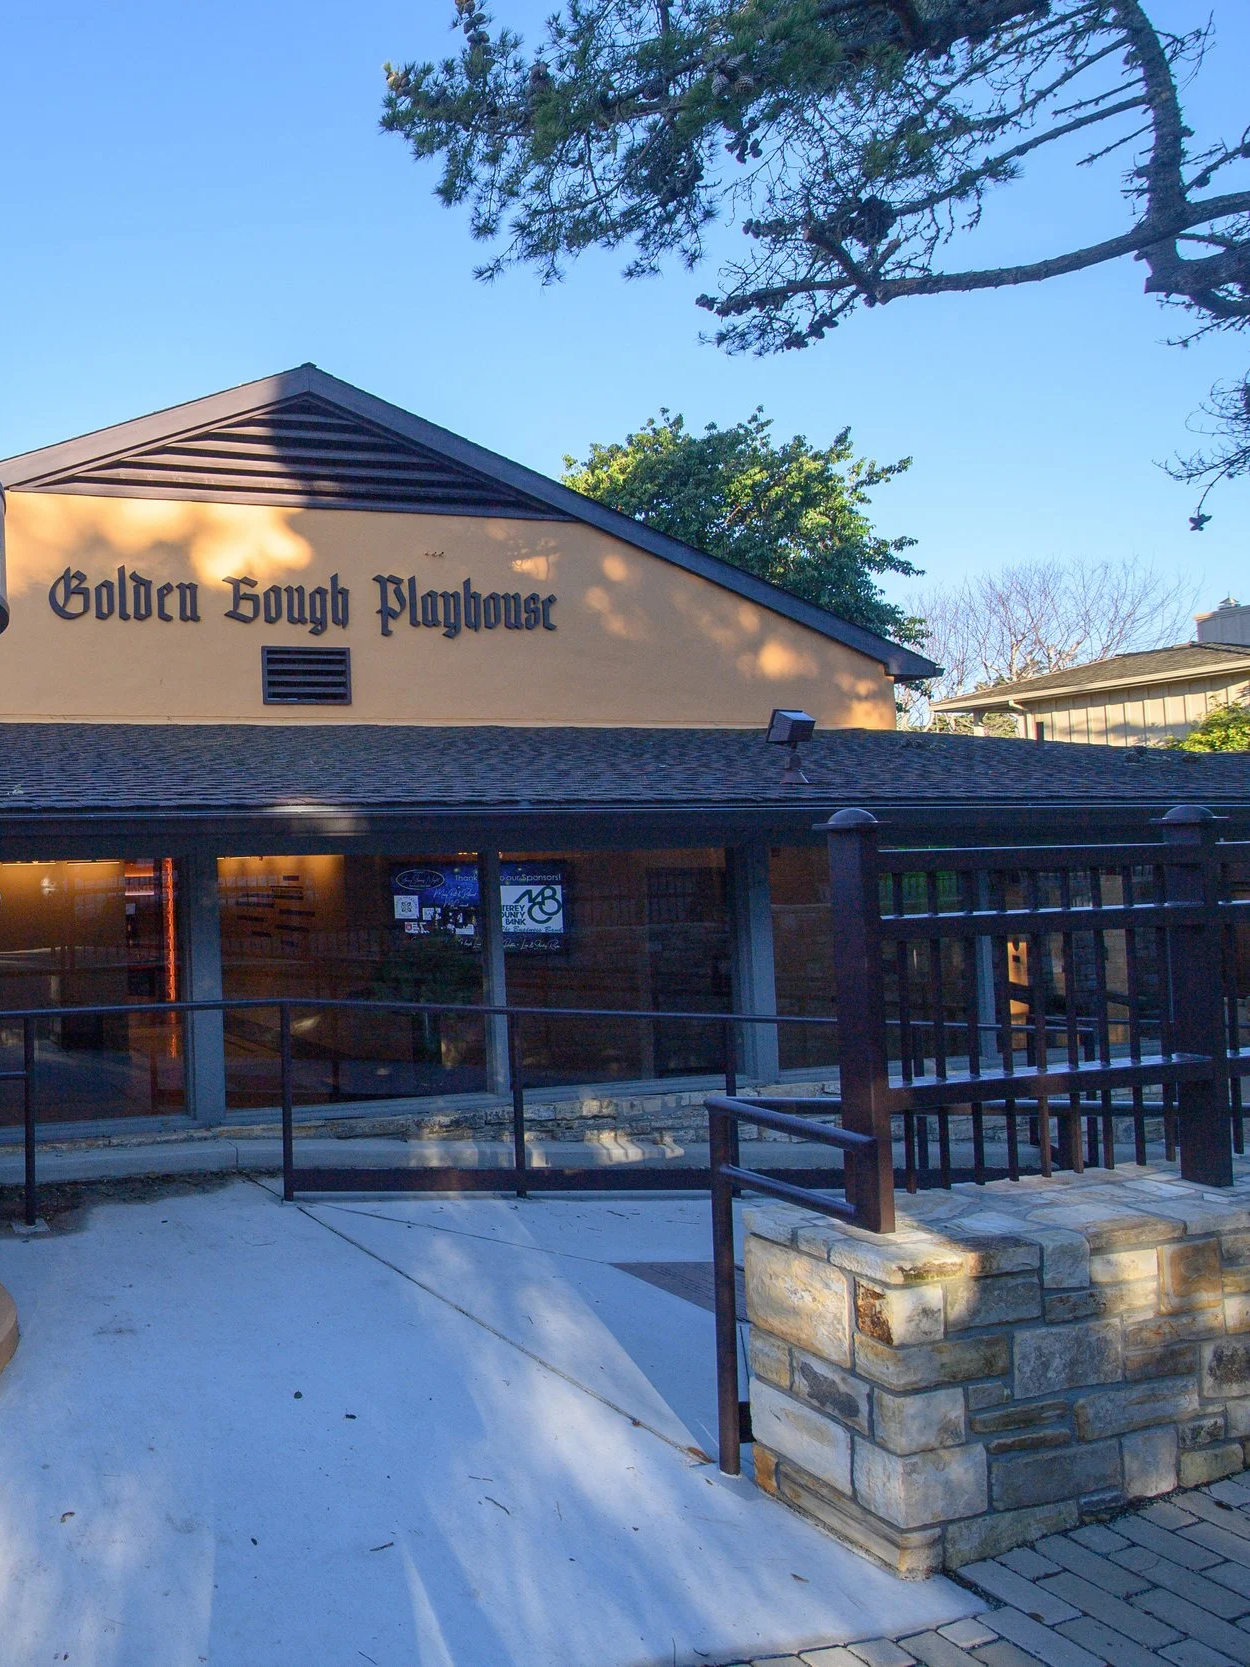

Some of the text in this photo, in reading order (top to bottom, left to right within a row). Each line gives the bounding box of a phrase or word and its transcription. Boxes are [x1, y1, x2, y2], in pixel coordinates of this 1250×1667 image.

[49, 565, 557, 638] Golden Bough Playhouse
[521, 874, 561, 882] Sponsors!
[501, 911, 526, 919] OUNTY
[505, 918, 526, 926] BANK
